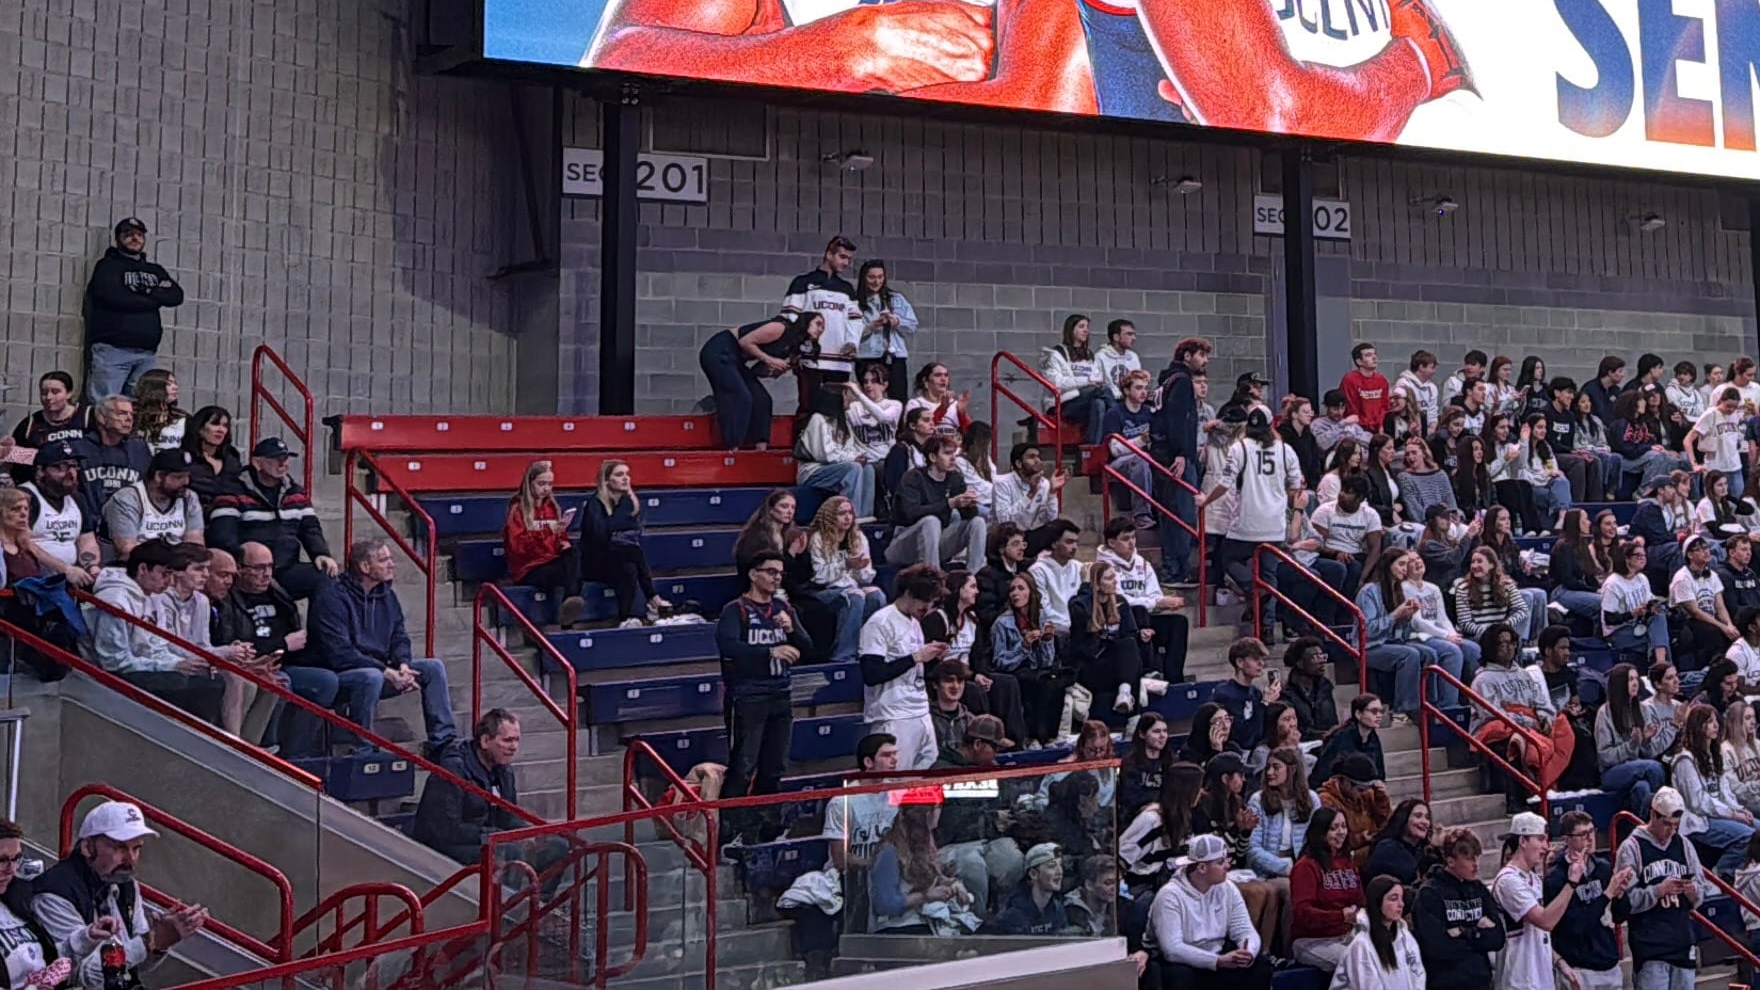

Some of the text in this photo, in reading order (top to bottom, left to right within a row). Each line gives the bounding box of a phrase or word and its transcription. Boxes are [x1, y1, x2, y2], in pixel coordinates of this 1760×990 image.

[636, 160, 704, 195] 201
[1255, 450, 1275, 476] 15
[84, 466, 139, 483] UCONN
[46, 520, 78, 530] UCONN
[145, 520, 183, 531] UCONN
